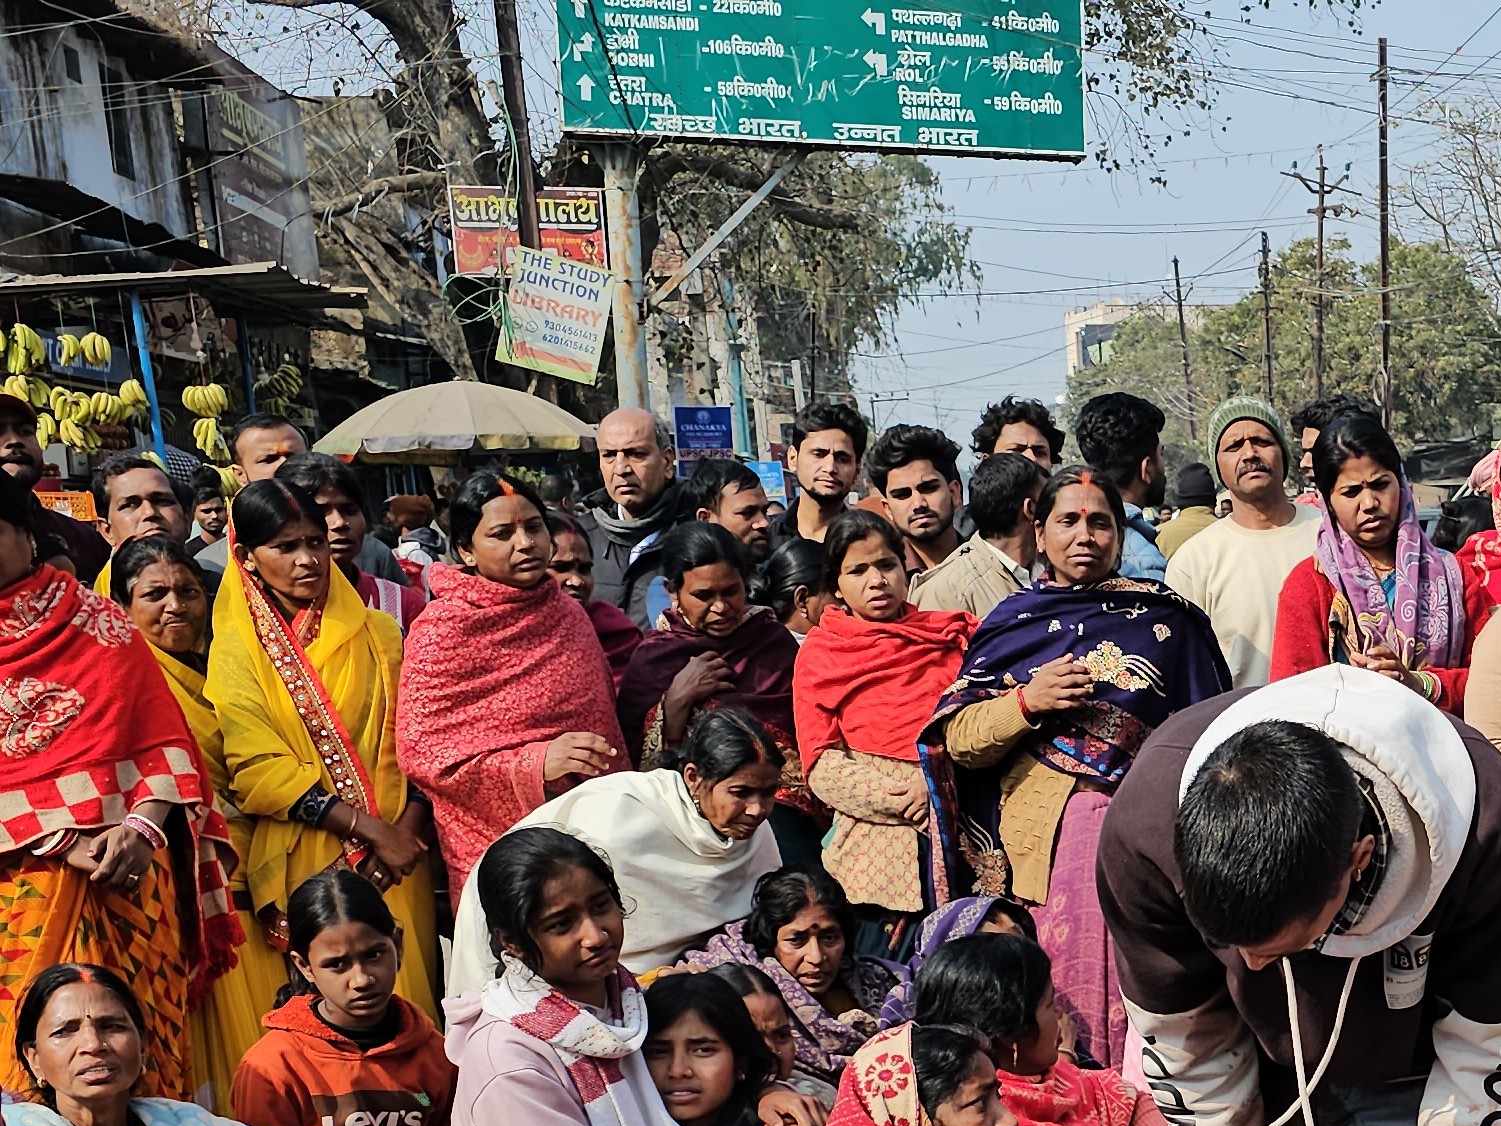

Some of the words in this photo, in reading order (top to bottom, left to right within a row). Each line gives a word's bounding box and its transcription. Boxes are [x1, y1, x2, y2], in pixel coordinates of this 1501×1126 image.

[604, 13, 699, 31] KATKAMSANDI
[891, 29, 989, 48] PATTHALGADHA
[897, 85, 961, 107] सिमरिया
[901, 107, 976, 122] SIMARIYA
[832, 123, 901, 142] उन्नत
[918, 127, 979, 146] भारत
[520, 250, 553, 271] THE
[558, 261, 614, 288] STUDY
[518, 267, 600, 302] JUNCTION
[513, 288, 603, 328] LIBRARY
[544, 319, 598, 342] 9304561413
